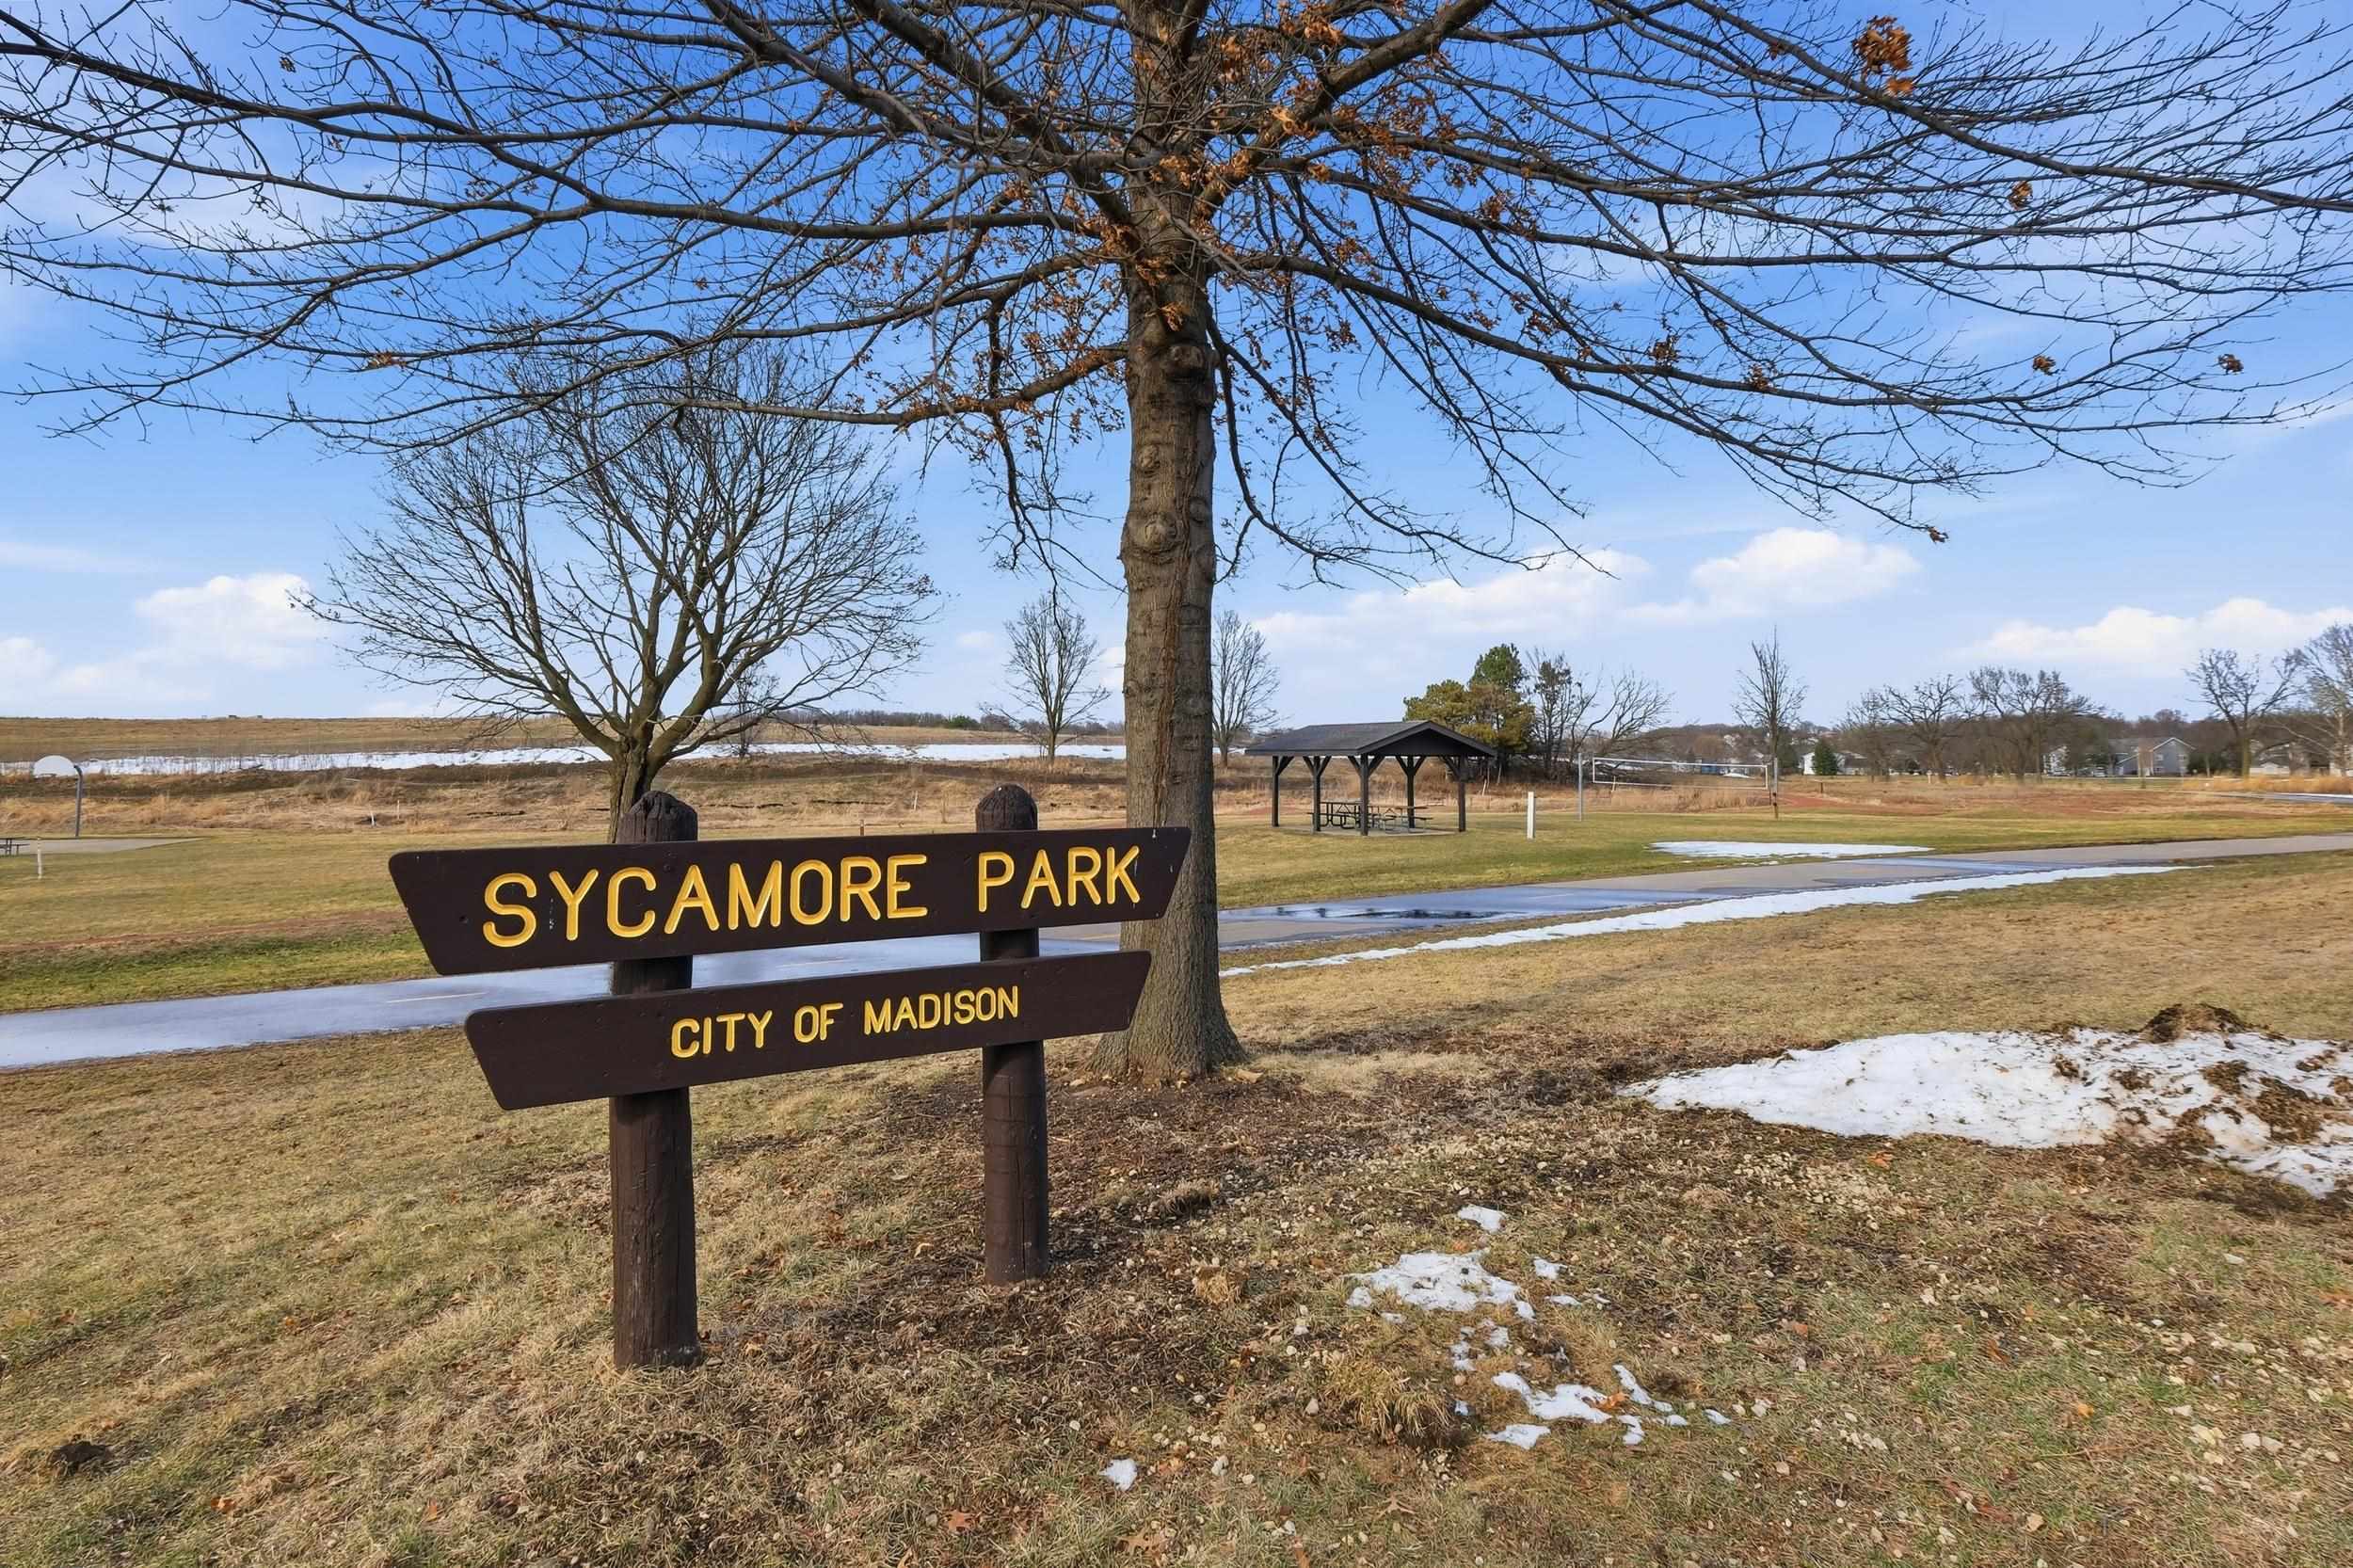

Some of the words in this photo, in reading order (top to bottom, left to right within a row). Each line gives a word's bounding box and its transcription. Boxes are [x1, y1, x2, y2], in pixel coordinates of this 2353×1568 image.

[482, 854, 928, 948] SYCAMORE
[978, 845, 1141, 913] PARK
[671, 1010, 773, 1059] CITY
[793, 1002, 844, 1044] OF
[864, 985, 1019, 1035] MADISON
